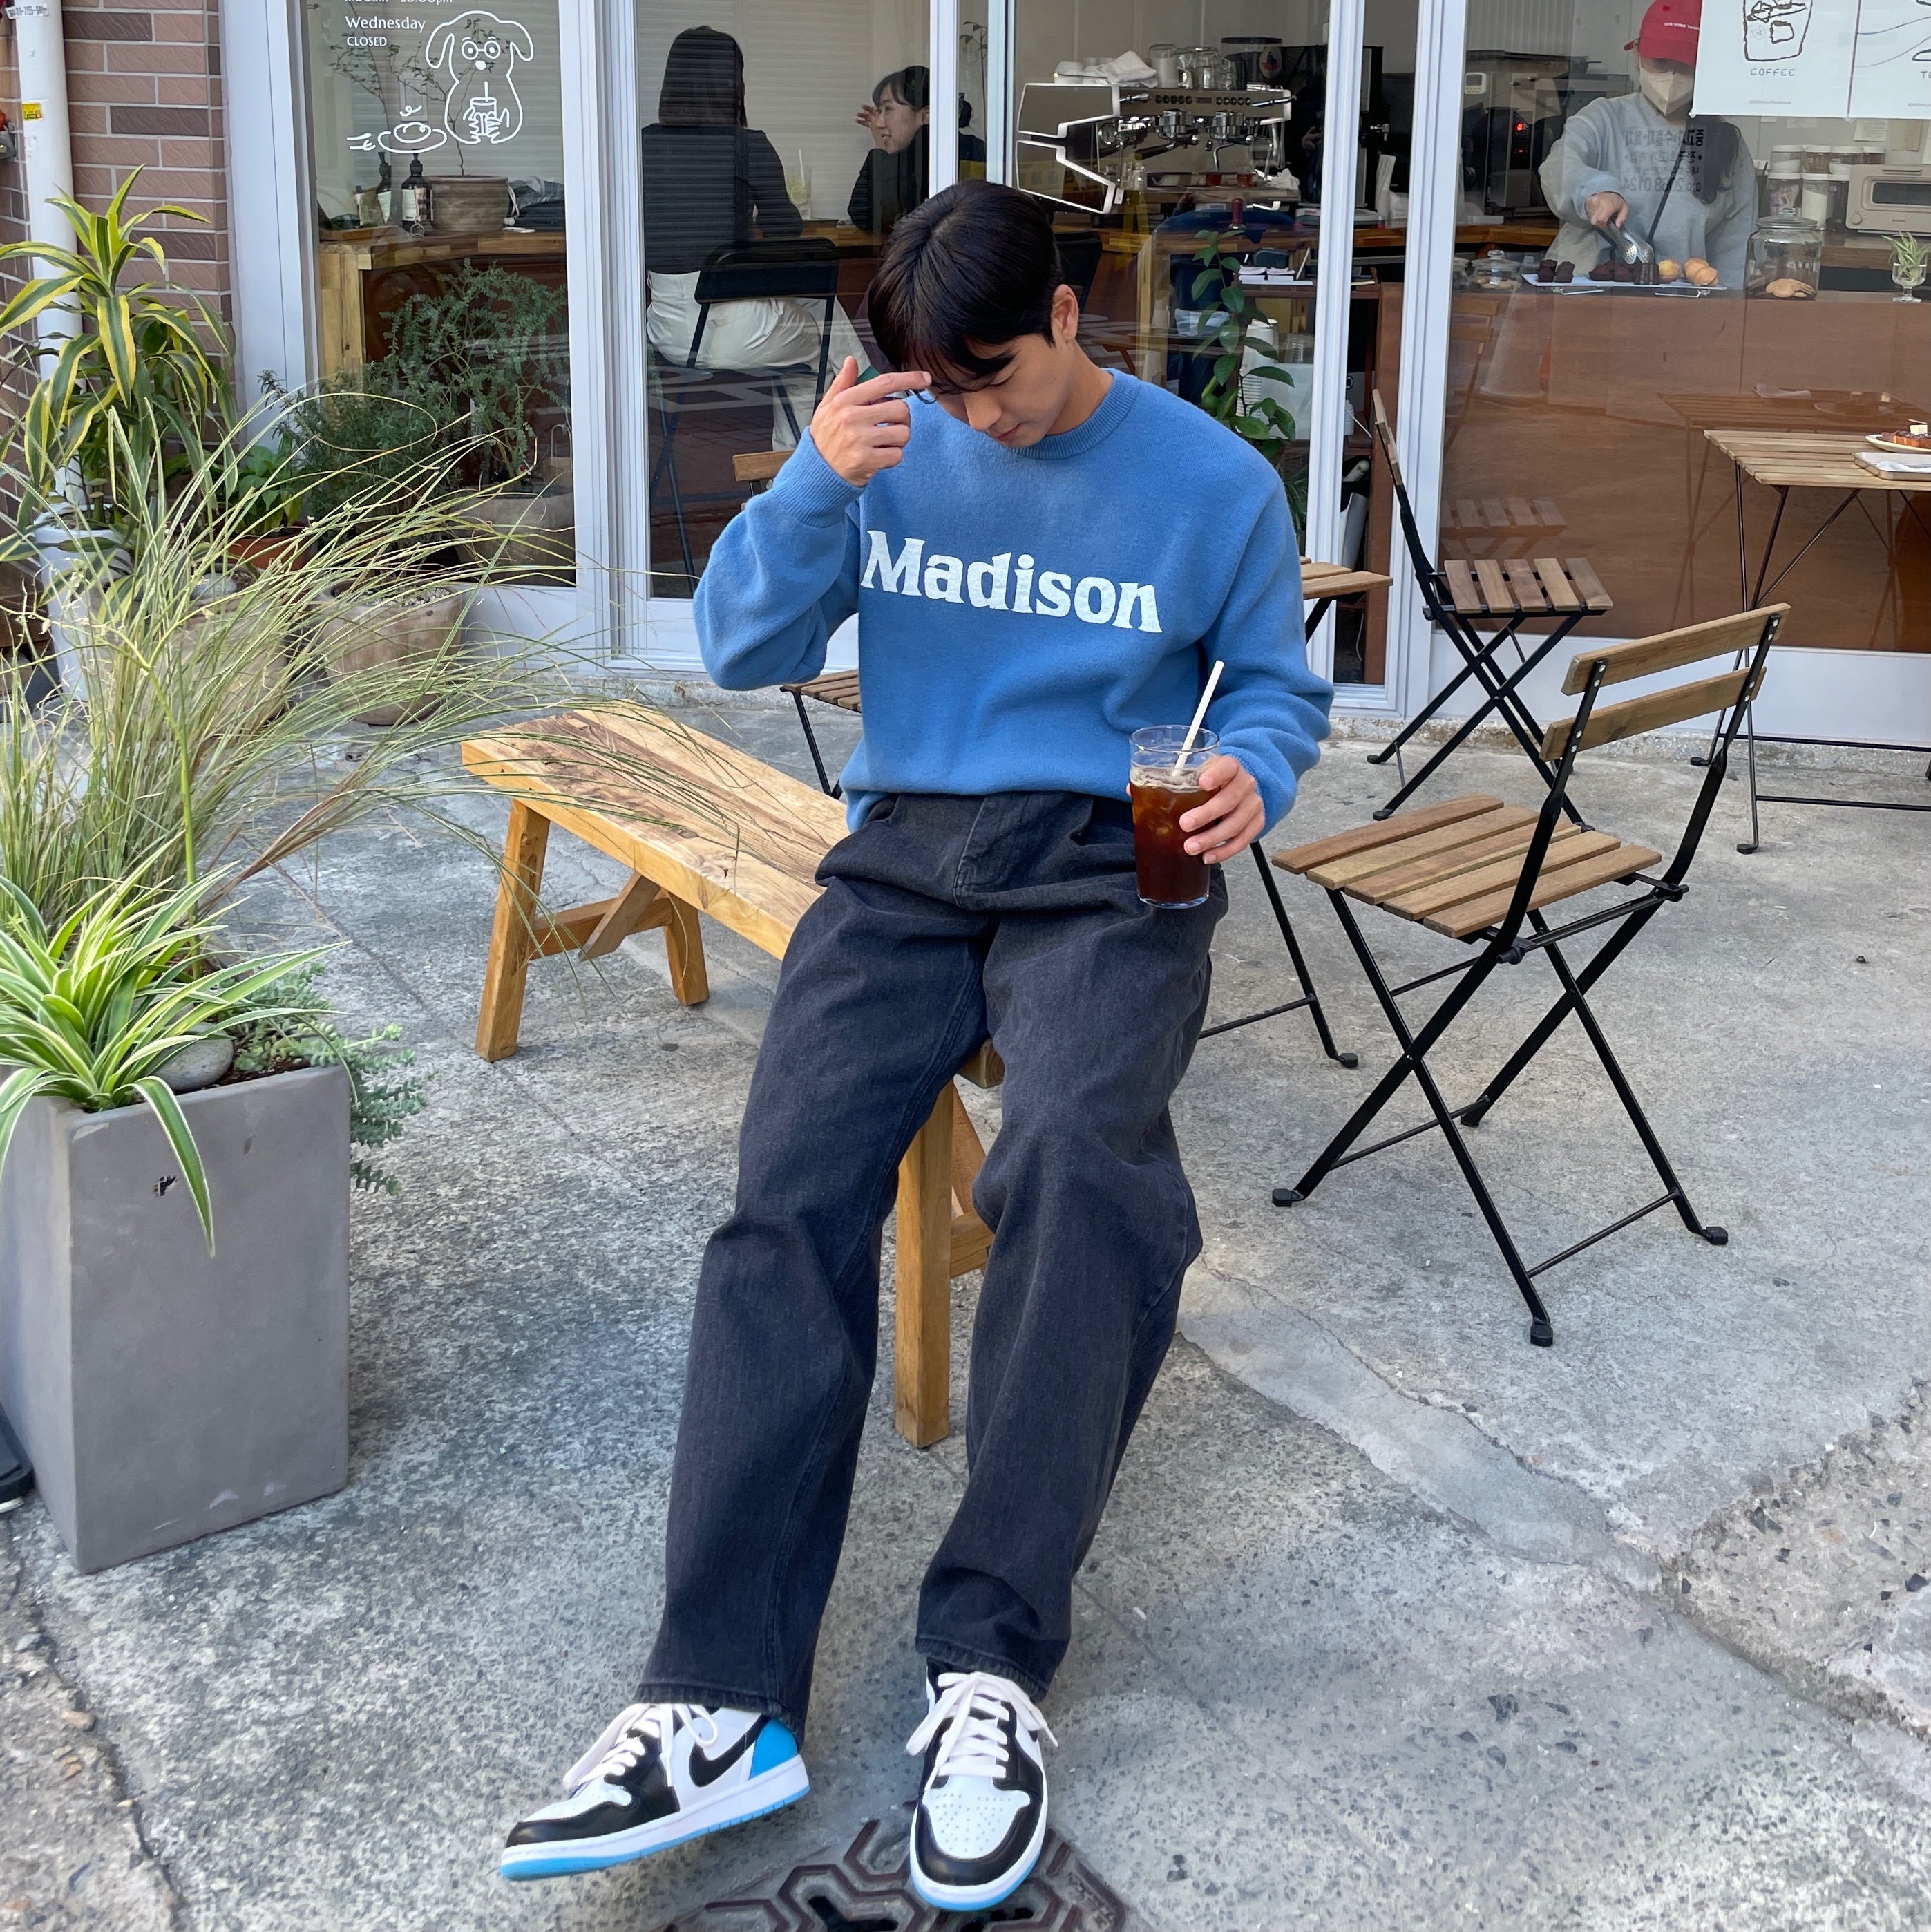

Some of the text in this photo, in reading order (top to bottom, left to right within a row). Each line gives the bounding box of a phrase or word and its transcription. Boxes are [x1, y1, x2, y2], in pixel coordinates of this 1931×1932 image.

[345, 16, 426, 34] Wednesday
[347, 36, 388, 47] CLOSED
[1750, 68, 1796, 77] COFFEE
[860, 530, 1163, 634] Madison
